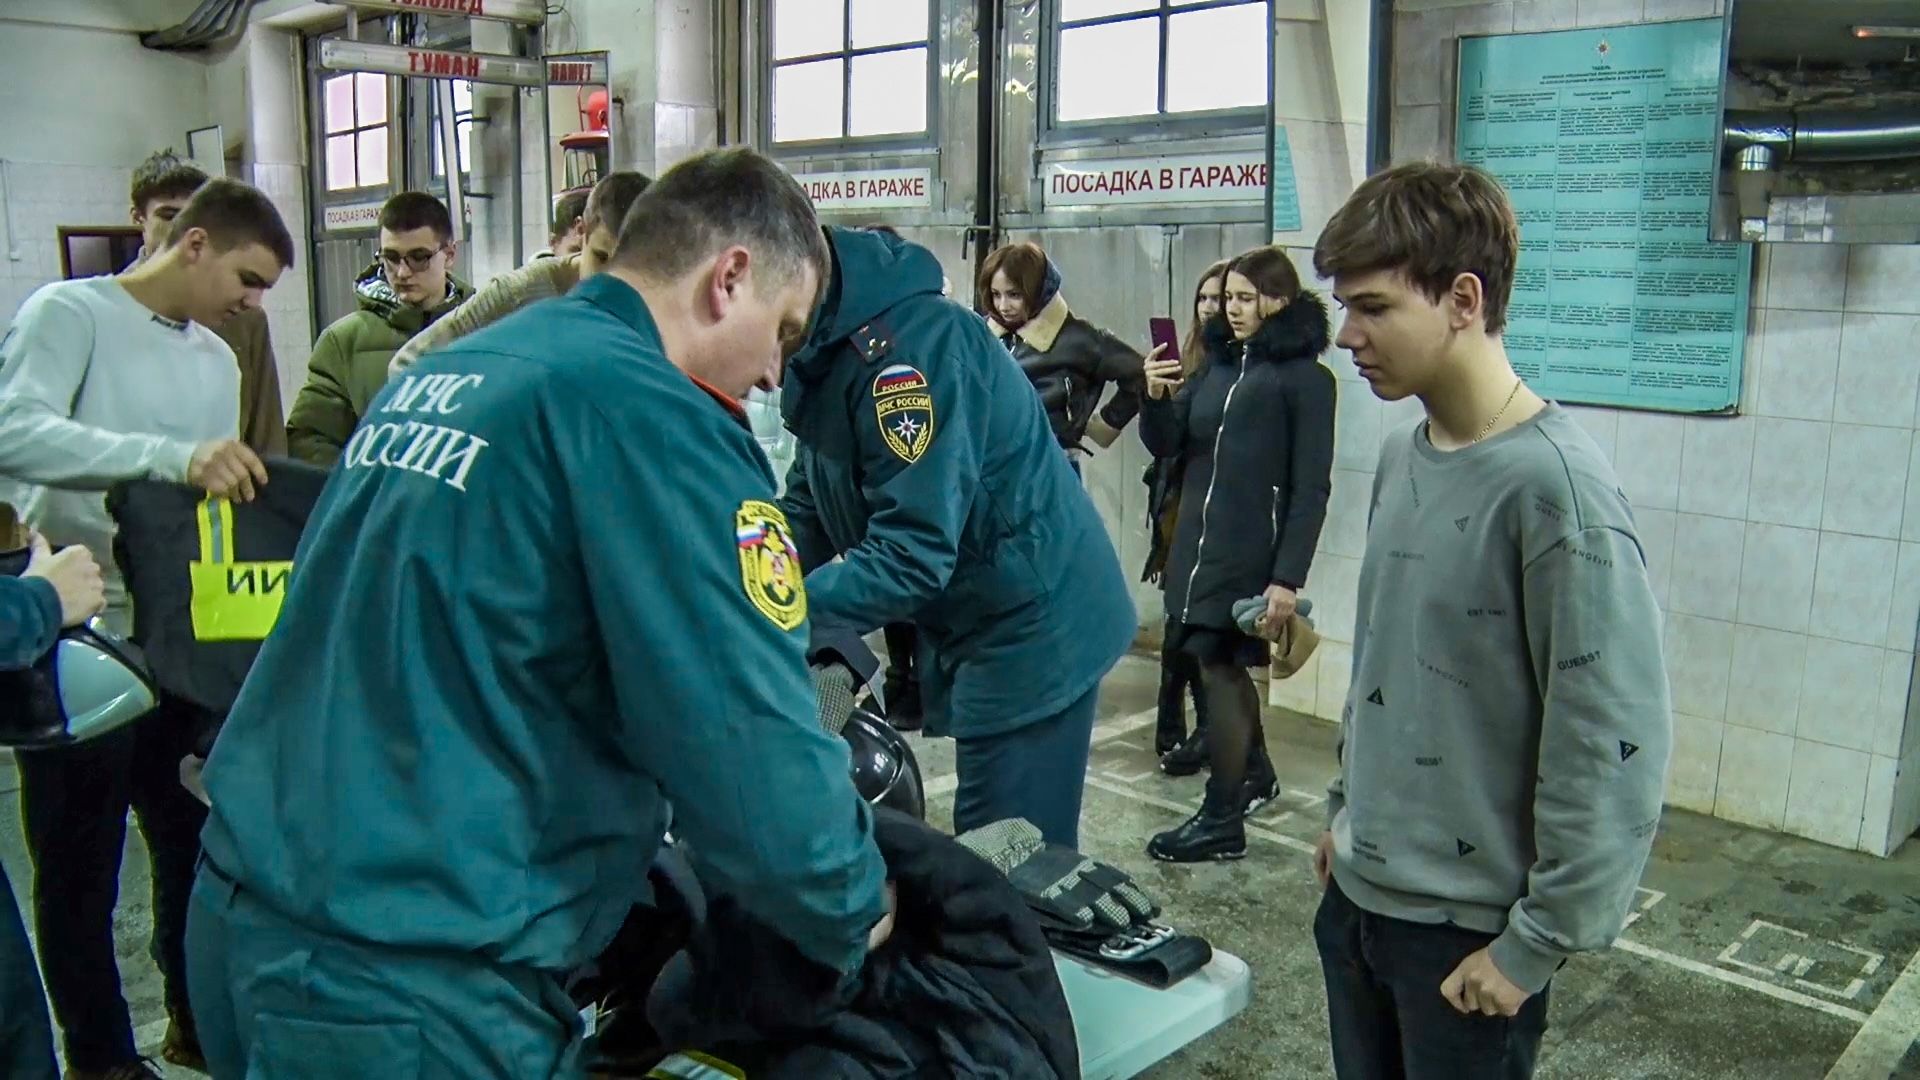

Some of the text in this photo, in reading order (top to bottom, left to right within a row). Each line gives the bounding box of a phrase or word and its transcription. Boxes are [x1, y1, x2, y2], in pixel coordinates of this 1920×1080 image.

[408, 52, 479, 77] ТУМАН
[803, 178, 924, 202] АДКА В ГАРАЖЕ
[1053, 170, 1153, 195] ПОСАДКА
[1160, 169, 1174, 189] В
[360, 208, 379, 220] ГАРАЖ
[380, 374, 485, 414] МЧС
[345, 421, 489, 492] ОССИИ
